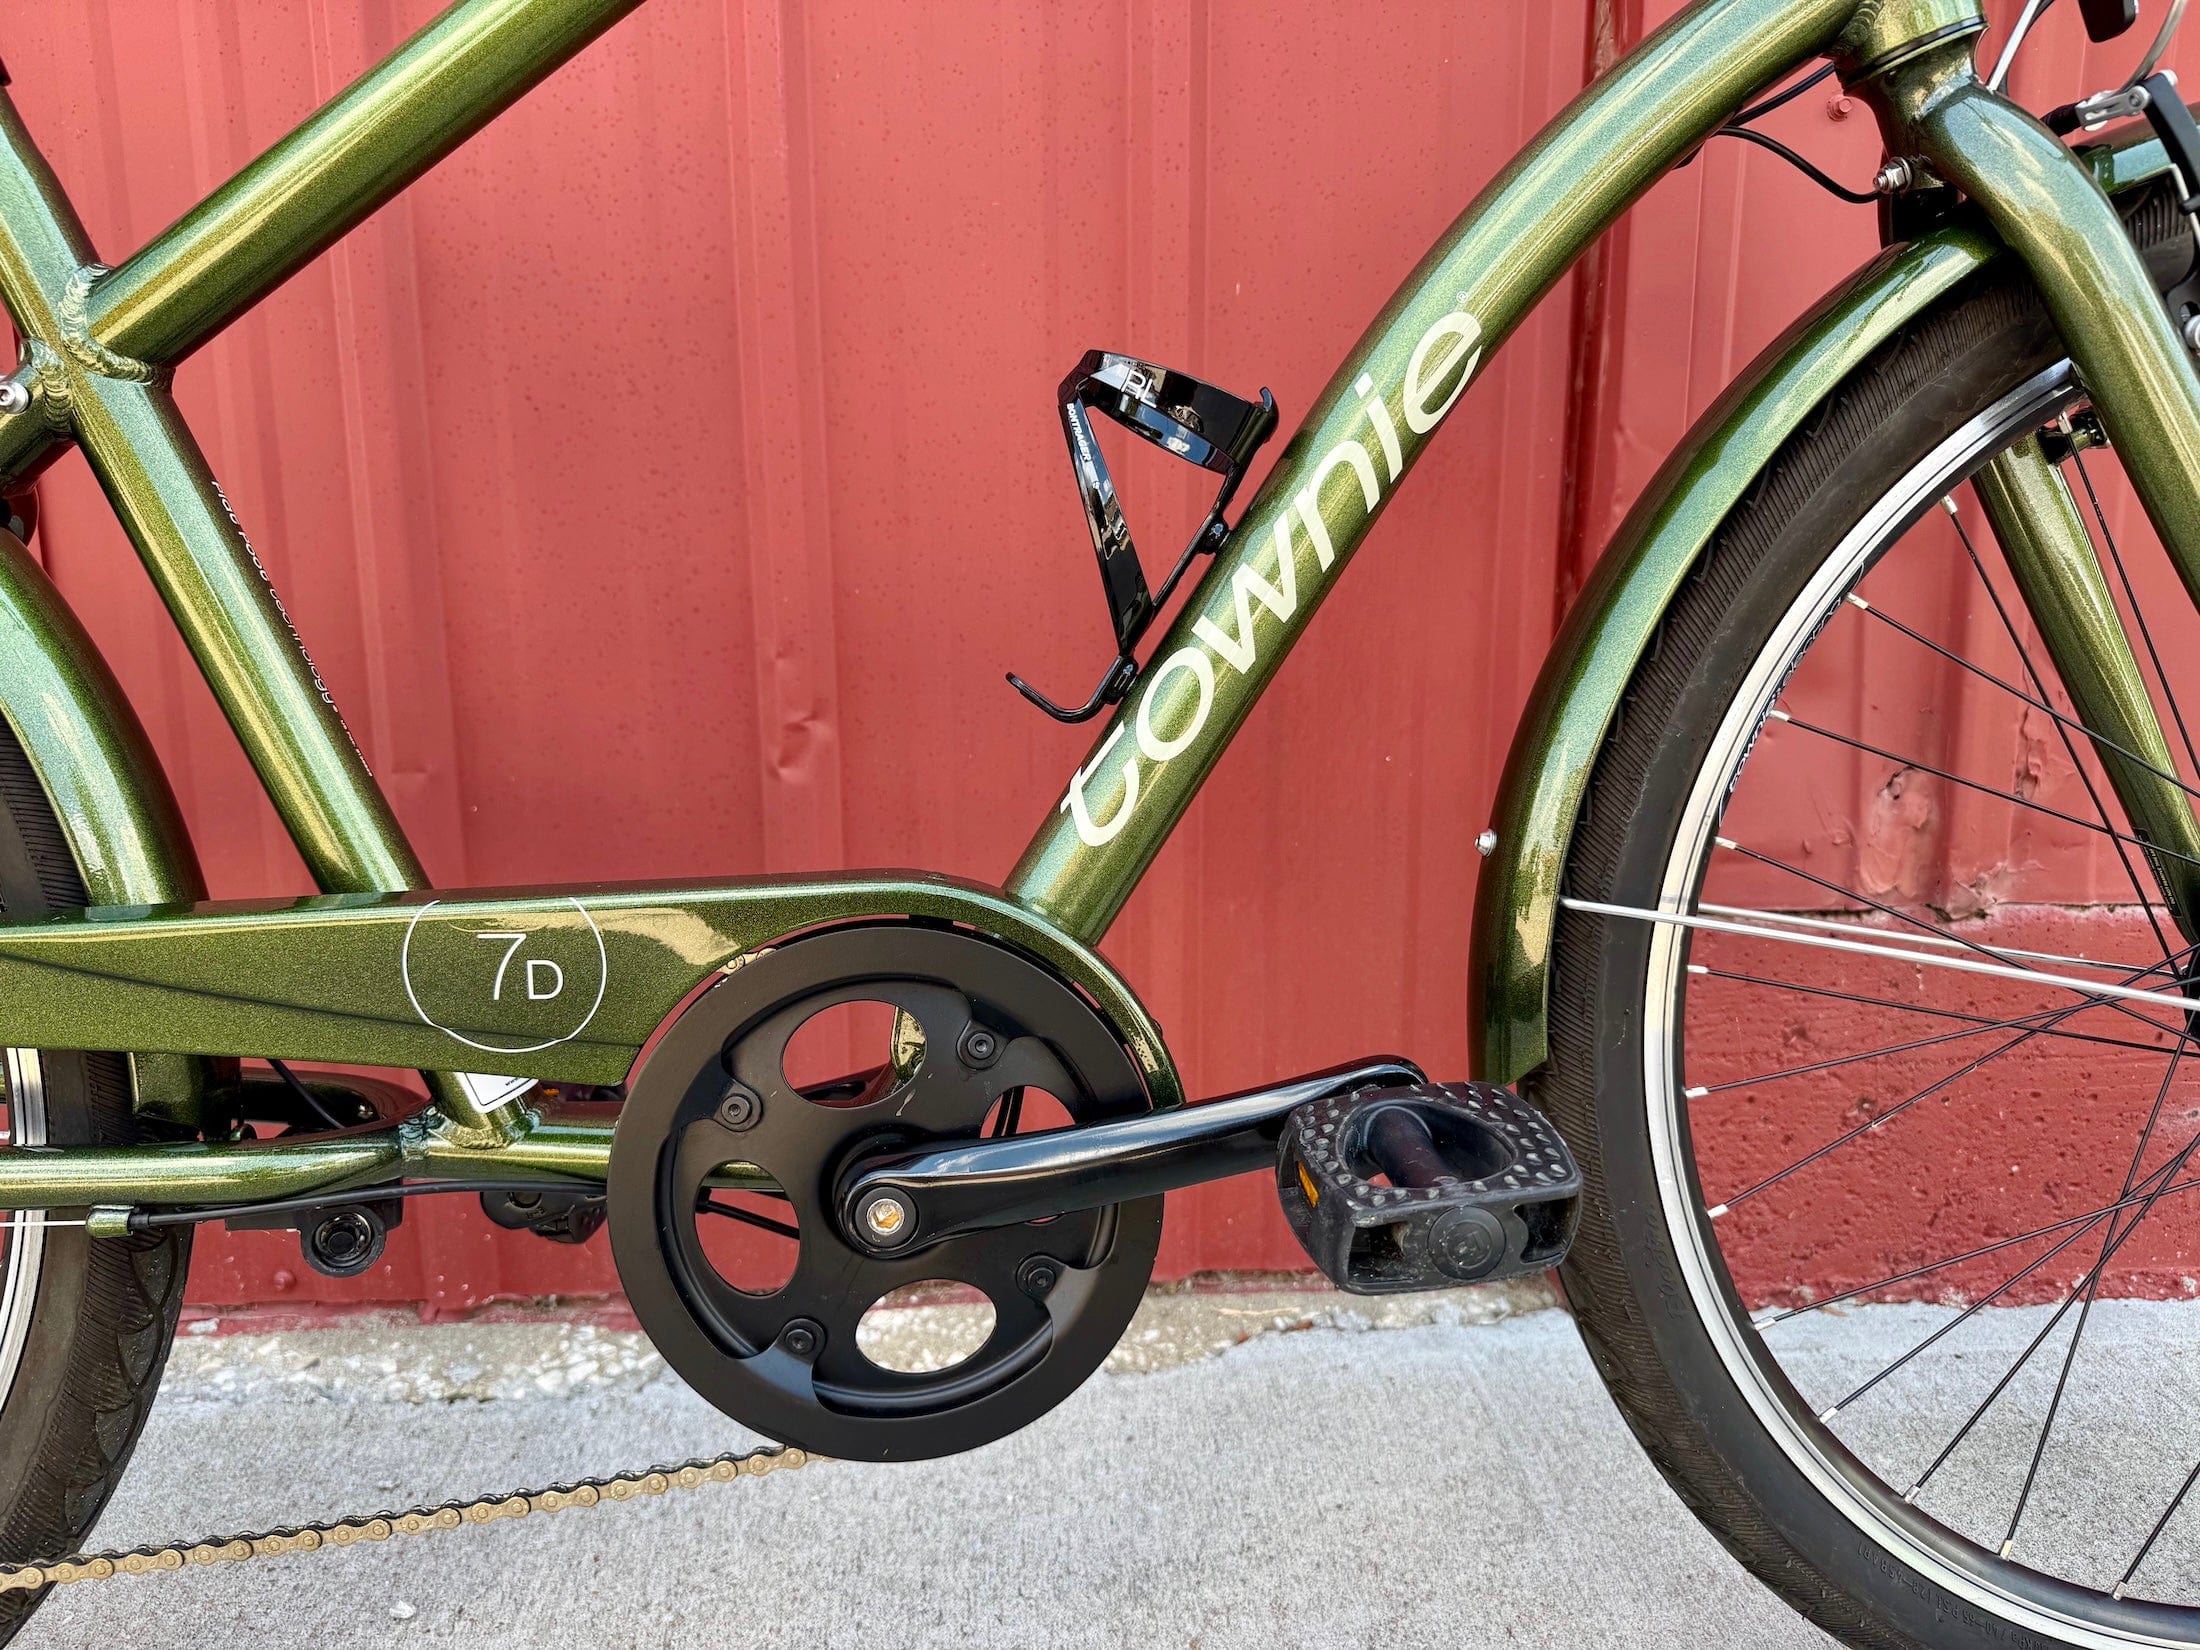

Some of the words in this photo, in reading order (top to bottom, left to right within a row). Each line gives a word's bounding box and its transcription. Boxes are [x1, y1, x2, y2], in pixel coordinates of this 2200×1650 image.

[1121, 369, 1157, 409] RL
[1066, 402, 1091, 462] BONTRAGER
[1060, 311, 1483, 847] townie
